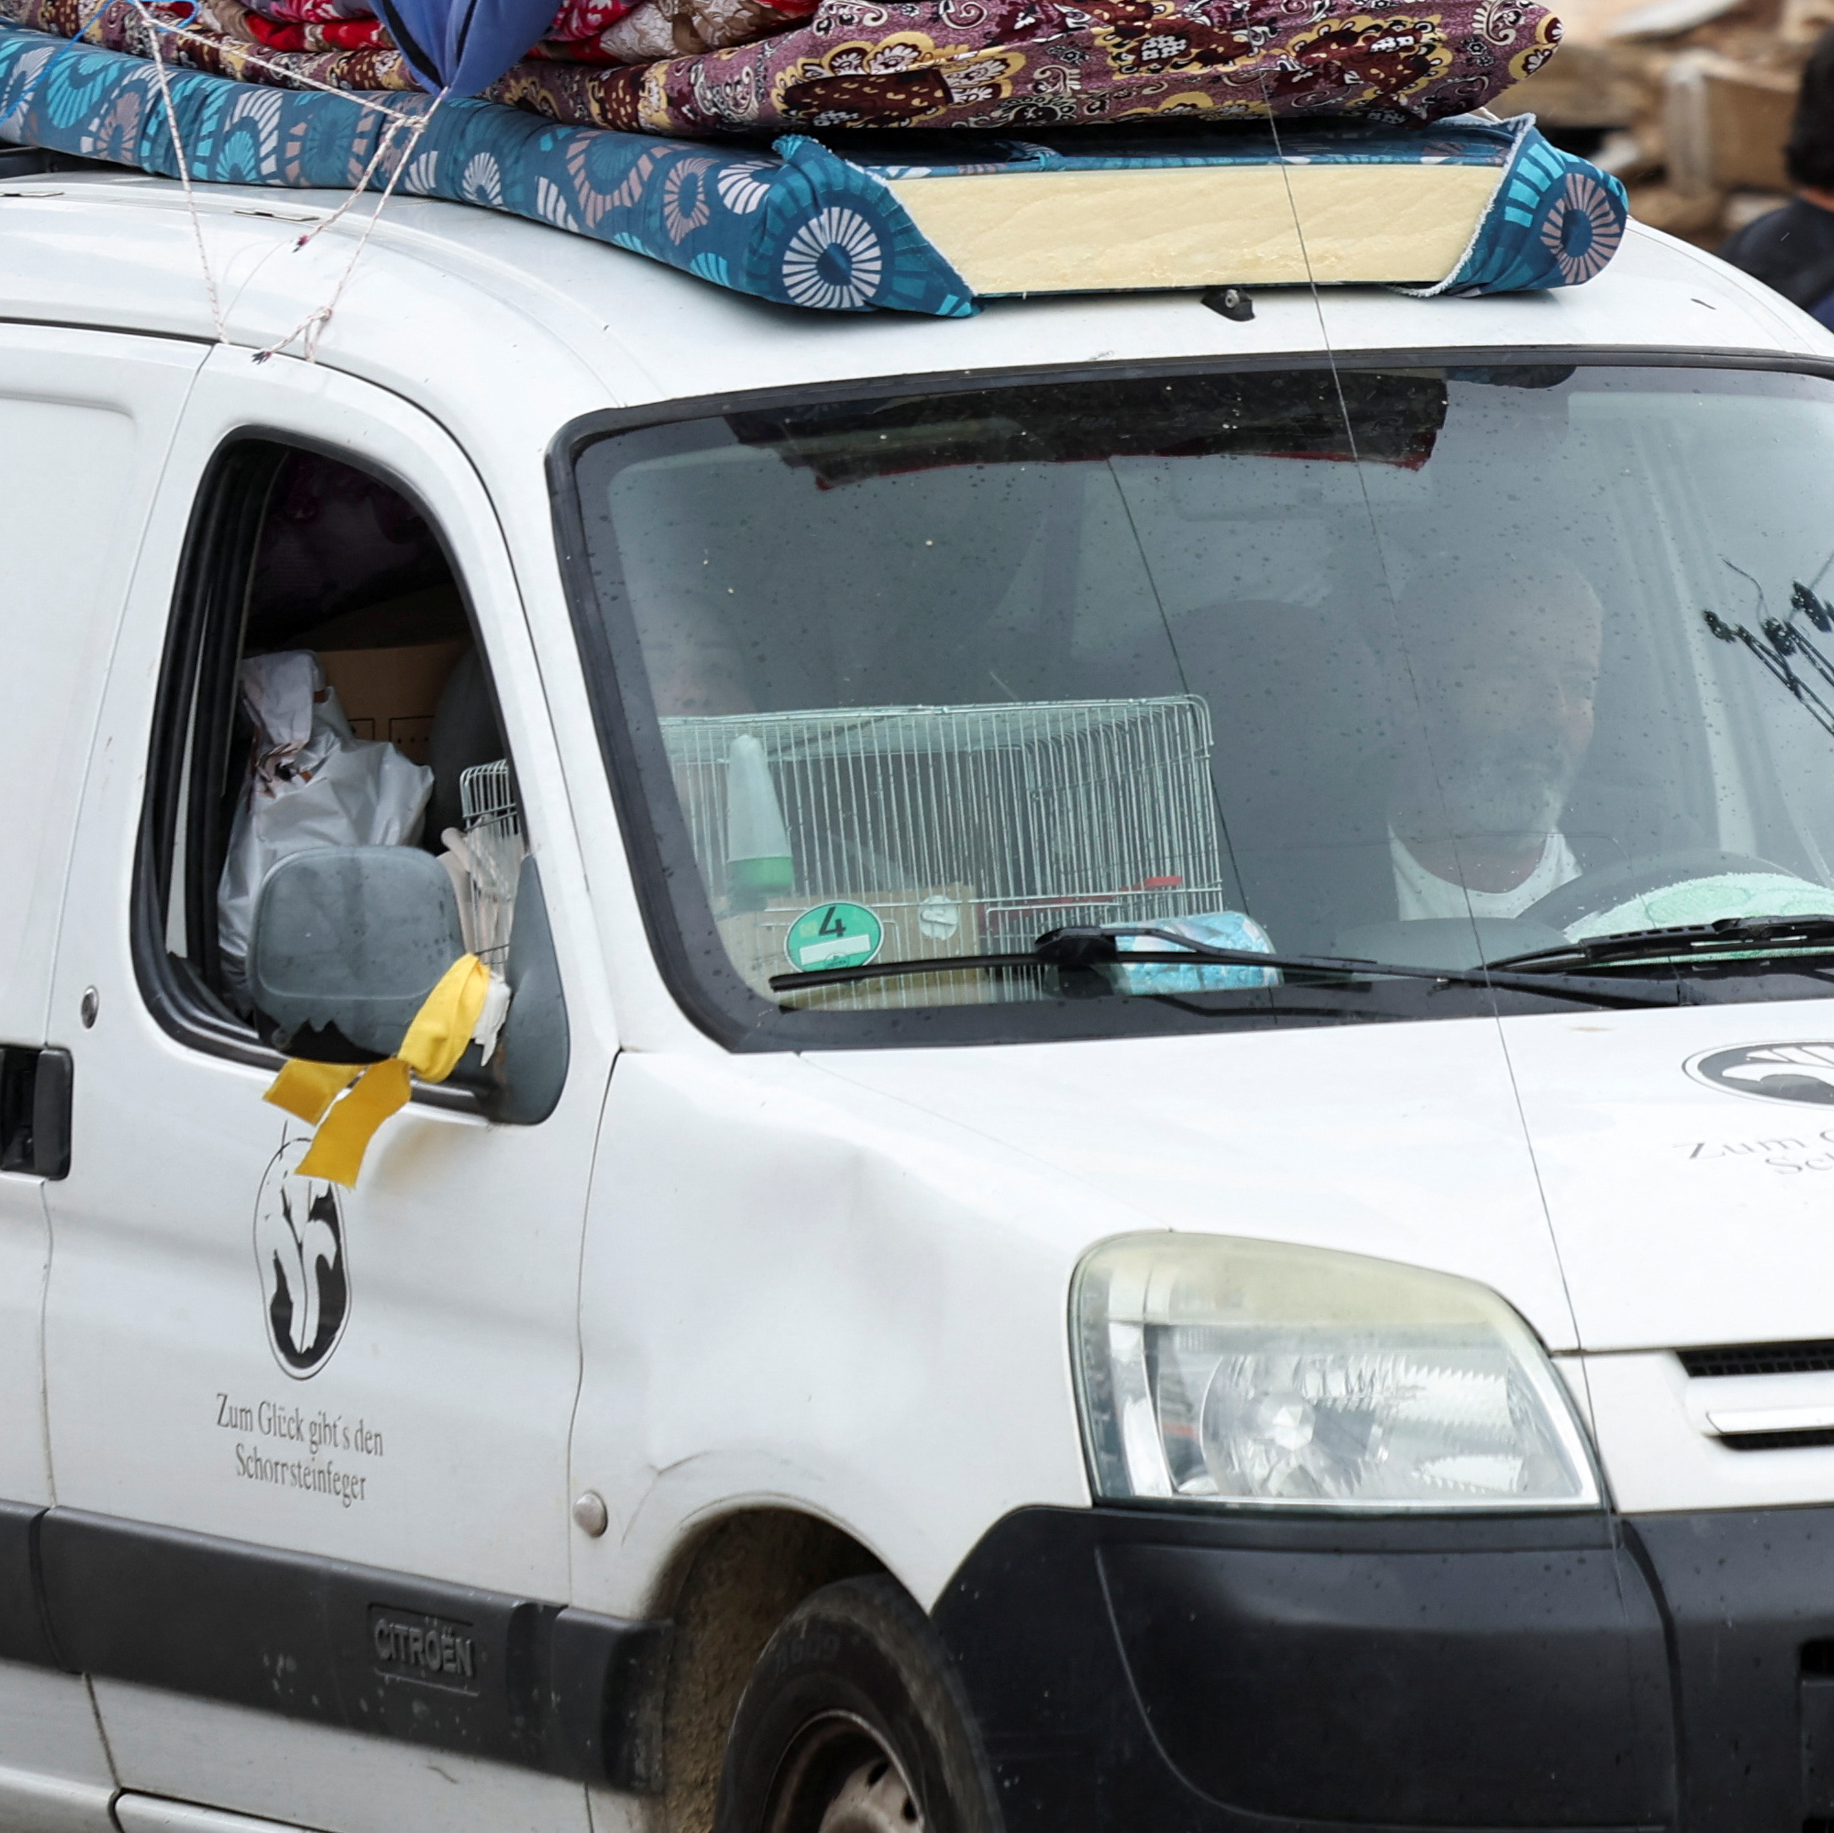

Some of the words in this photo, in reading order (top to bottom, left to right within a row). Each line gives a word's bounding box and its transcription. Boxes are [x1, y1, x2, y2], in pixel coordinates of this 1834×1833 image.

[818, 906, 846, 937] 4
[1672, 1141, 1808, 1160] Zum
[216, 1392, 254, 1432] Zum
[354, 1418, 384, 1457] den
